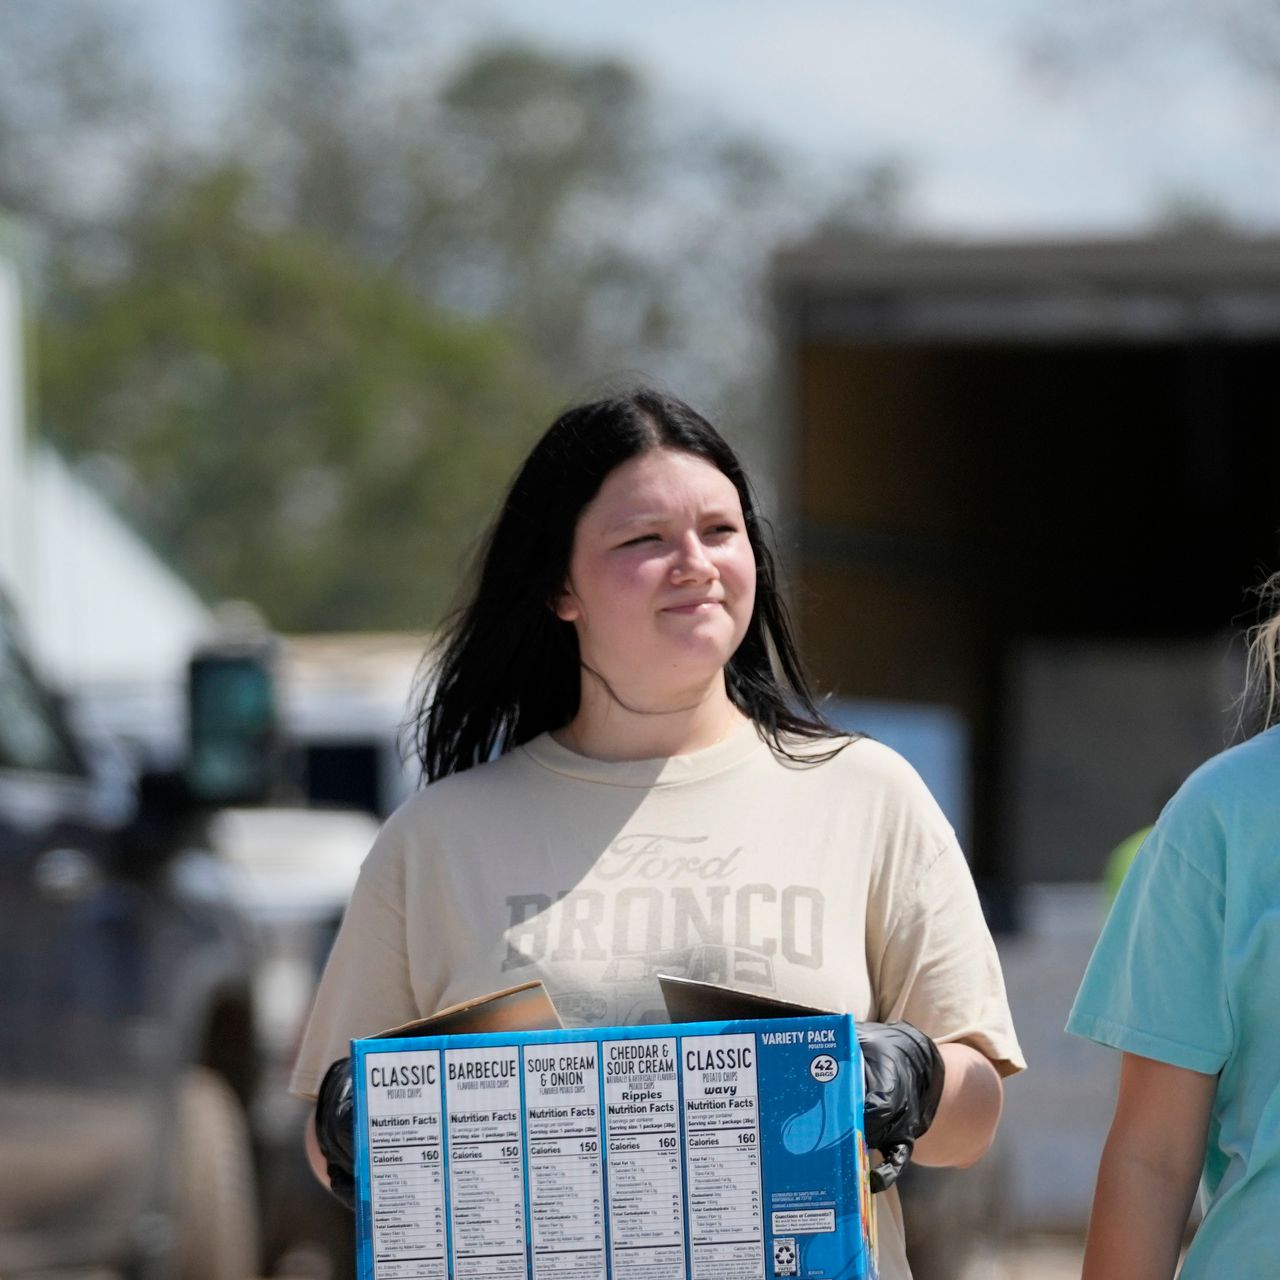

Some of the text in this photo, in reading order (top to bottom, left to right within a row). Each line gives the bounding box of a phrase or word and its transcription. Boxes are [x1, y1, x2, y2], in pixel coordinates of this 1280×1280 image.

[594, 833, 744, 881] Ford
[501, 883, 826, 973] BRONCO
[761, 1029, 835, 1045] VARIETY PACK
[610, 1044, 669, 1060] CHEDDAR &
[528, 1056, 595, 1073] SOUR CREAM
[686, 1048, 752, 1071] CLASSIC
[814, 1060, 833, 1071] 42
[448, 1060, 516, 1080] BARBECUE
[607, 1059, 674, 1075] SOUR CREAM
[371, 1065, 436, 1087] CLASSIC
[540, 1071, 583, 1087] & ONION
[703, 1071, 738, 1083] POTATO CHIPS
[387, 1088, 422, 1100] POTATO CHIPS
[622, 1091, 663, 1102] Ripples
[704, 1086, 737, 1096] wavy
[609, 1103, 674, 1114] Nutrition Facts
[688, 1099, 753, 1111] Nutrition Facts
[451, 1112, 517, 1123] Nutrition Facts
[529, 1107, 595, 1119] Nutrition Facts
[371, 1116, 437, 1127] Nutrition Facts
[610, 1138, 676, 1150] Calories 160
[689, 1134, 756, 1146] Calories 160
[452, 1147, 518, 1159] Calories 150
[531, 1142, 597, 1155] Calories 150
[373, 1150, 439, 1163] Calories 160
